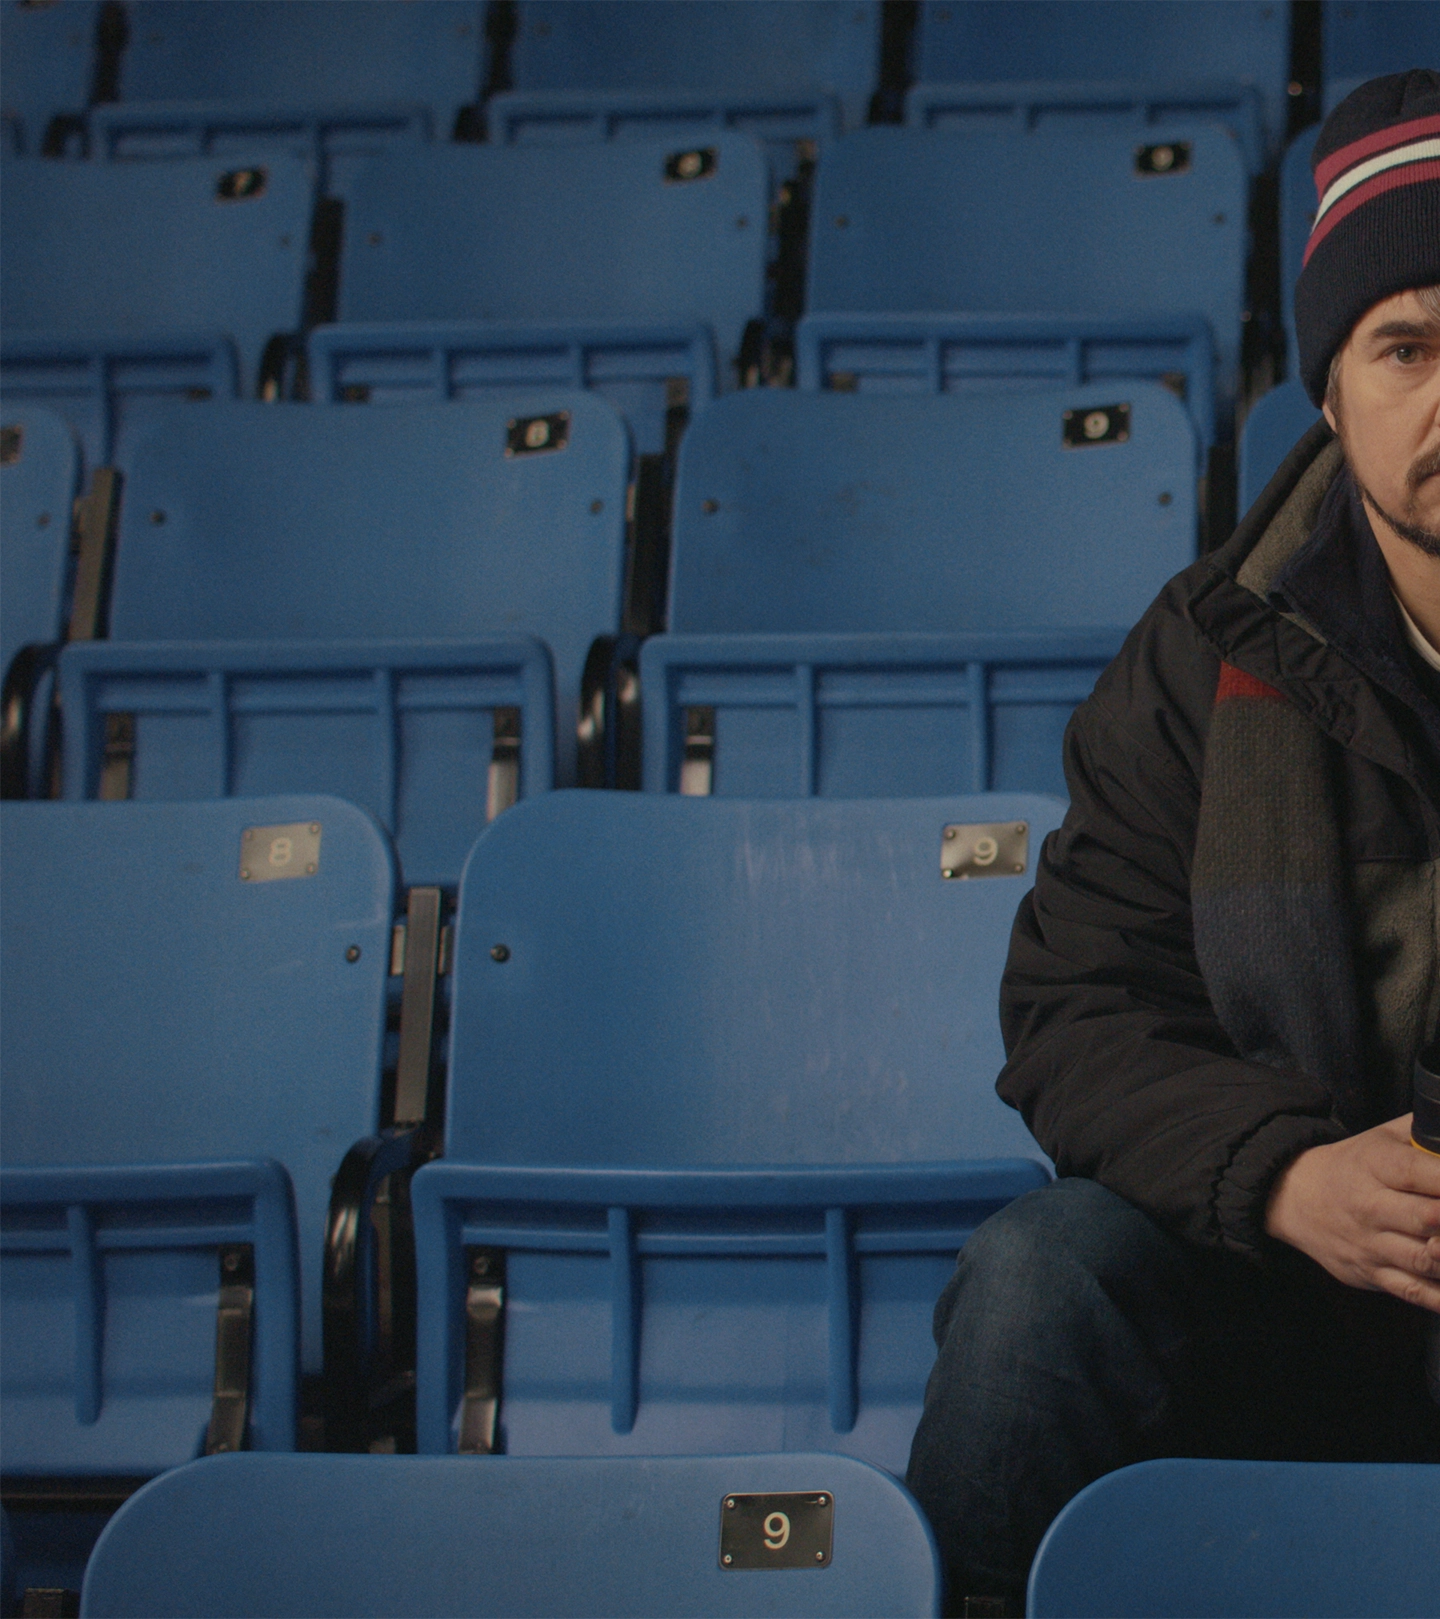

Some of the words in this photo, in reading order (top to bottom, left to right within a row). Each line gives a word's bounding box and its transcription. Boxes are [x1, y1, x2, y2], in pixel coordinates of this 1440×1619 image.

[1084, 411, 1110, 439] 9
[269, 836, 292, 867] 8
[972, 836, 999, 866] 9
[763, 1510, 791, 1550] 9
